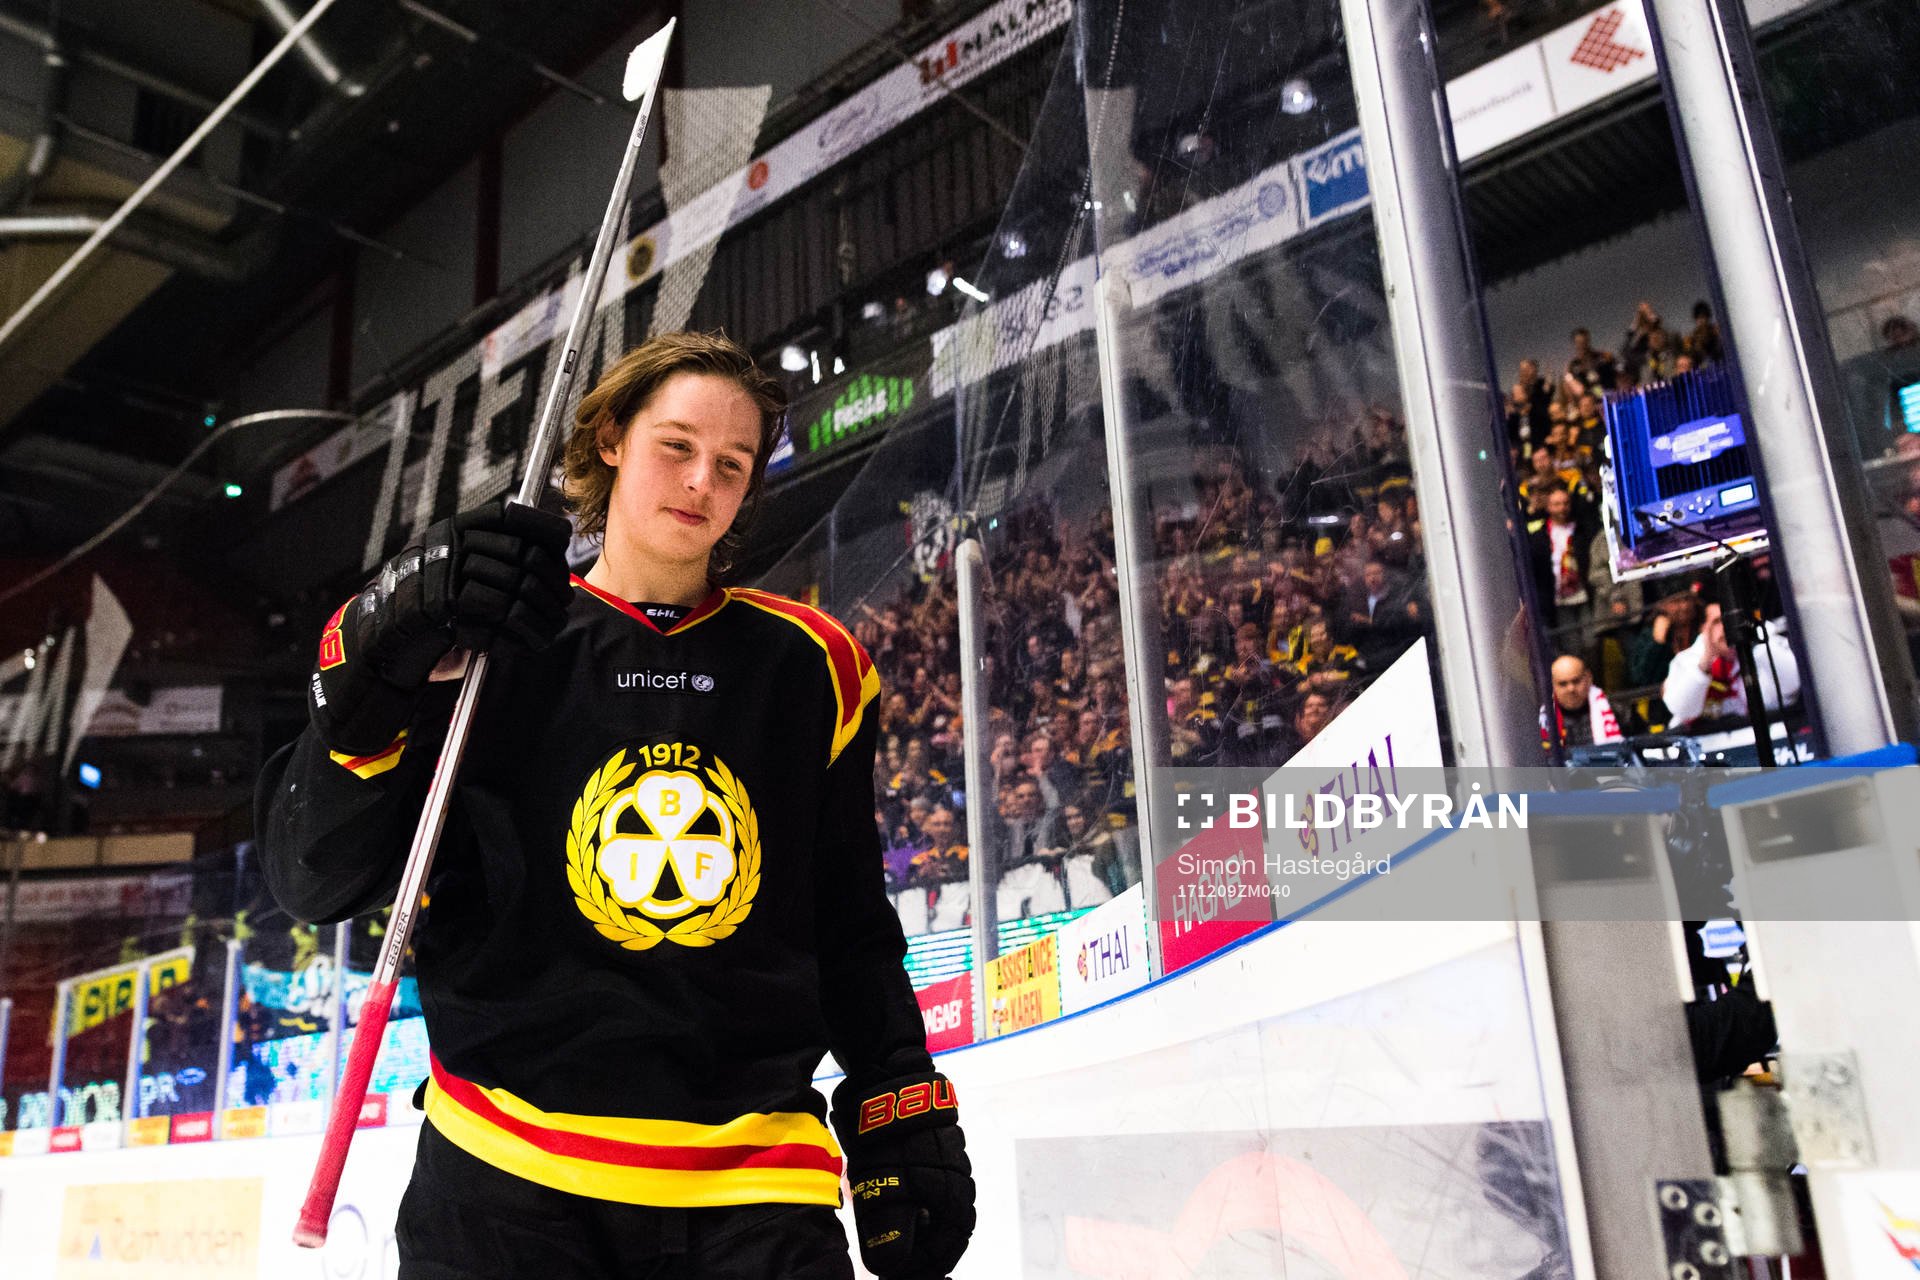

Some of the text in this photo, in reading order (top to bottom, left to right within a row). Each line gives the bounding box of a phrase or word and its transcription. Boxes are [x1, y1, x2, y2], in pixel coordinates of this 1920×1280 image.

[645, 608, 681, 619] SHL
[616, 669, 688, 690] unicef
[638, 741, 702, 770] 1912
[658, 788, 682, 817] B
[629, 851, 714, 881] I F
[996, 937, 1053, 990] ASSISTANCE
[1089, 924, 1130, 982] THAI
[921, 998, 962, 1035] AGAB
[850, 1176, 900, 1198] NEXUS
